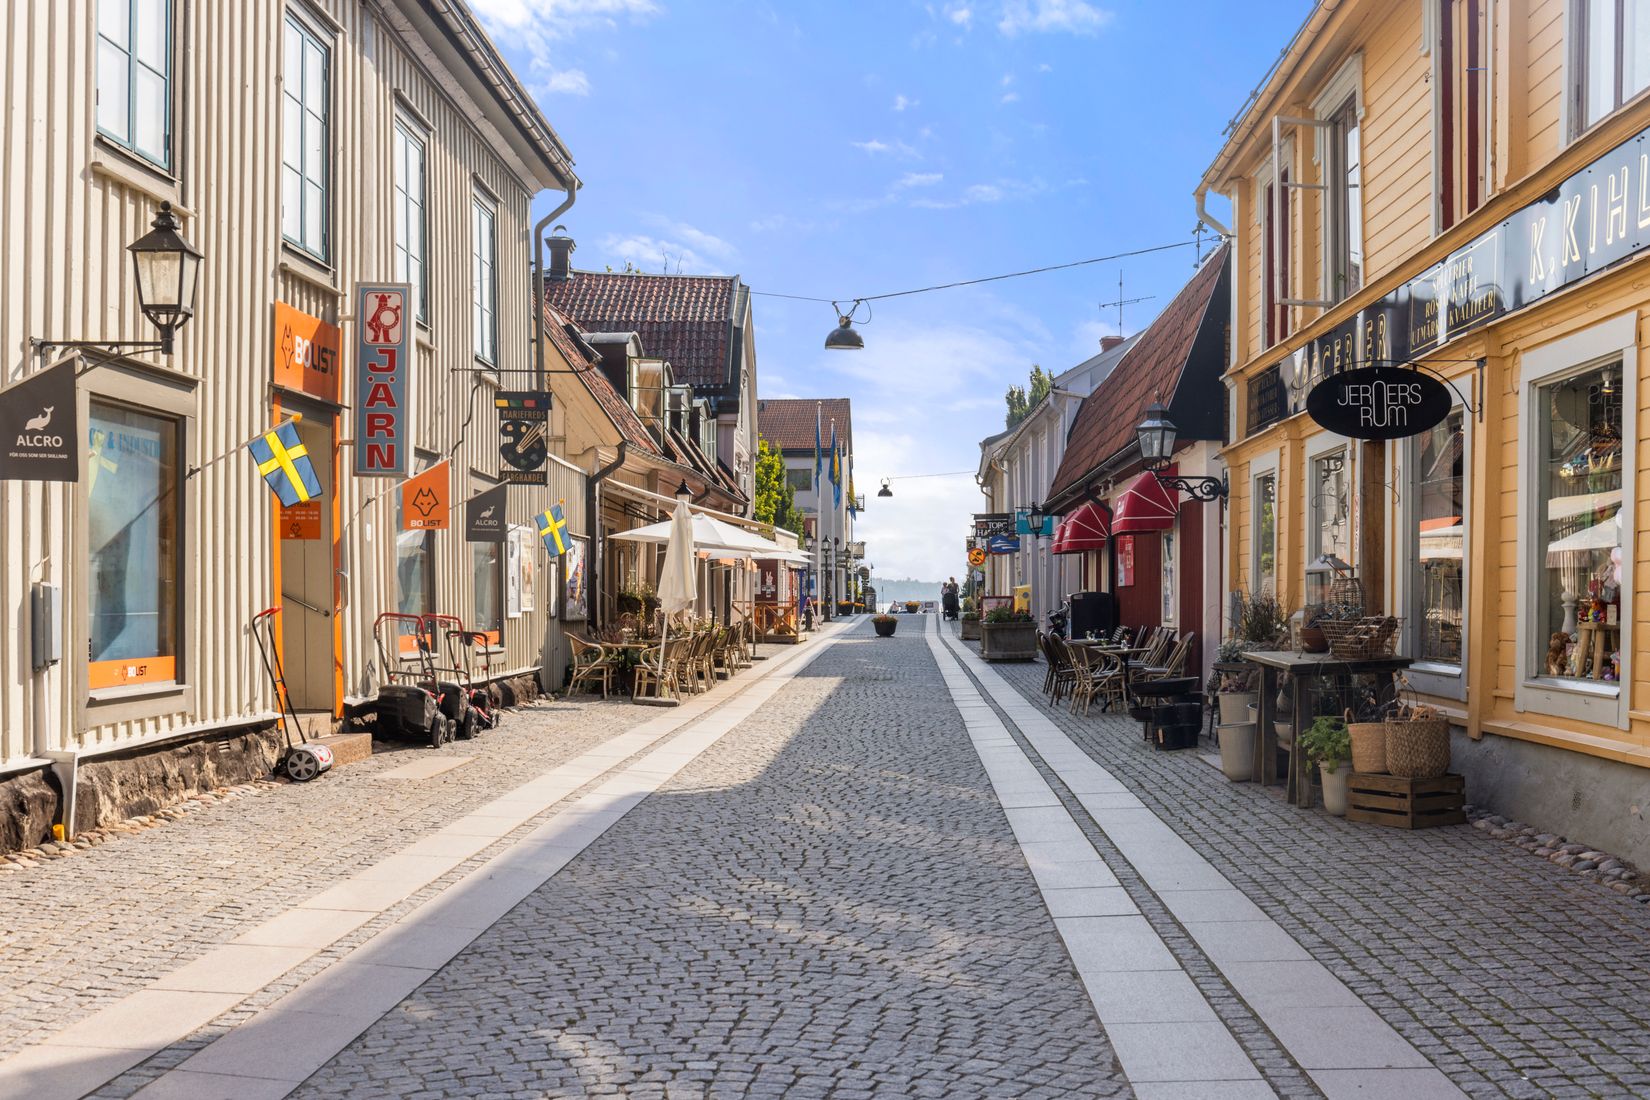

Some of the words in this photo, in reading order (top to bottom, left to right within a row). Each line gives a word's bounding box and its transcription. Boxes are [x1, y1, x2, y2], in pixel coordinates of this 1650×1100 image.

[294, 335, 336, 376] BOLIST
[364, 347, 399, 469] JÄRN
[502, 410, 546, 419] MARIEFREDS
[16, 434, 63, 447] ALCRO
[410, 519, 441, 527] BOLIST
[127, 665, 147, 678] BOLIST
